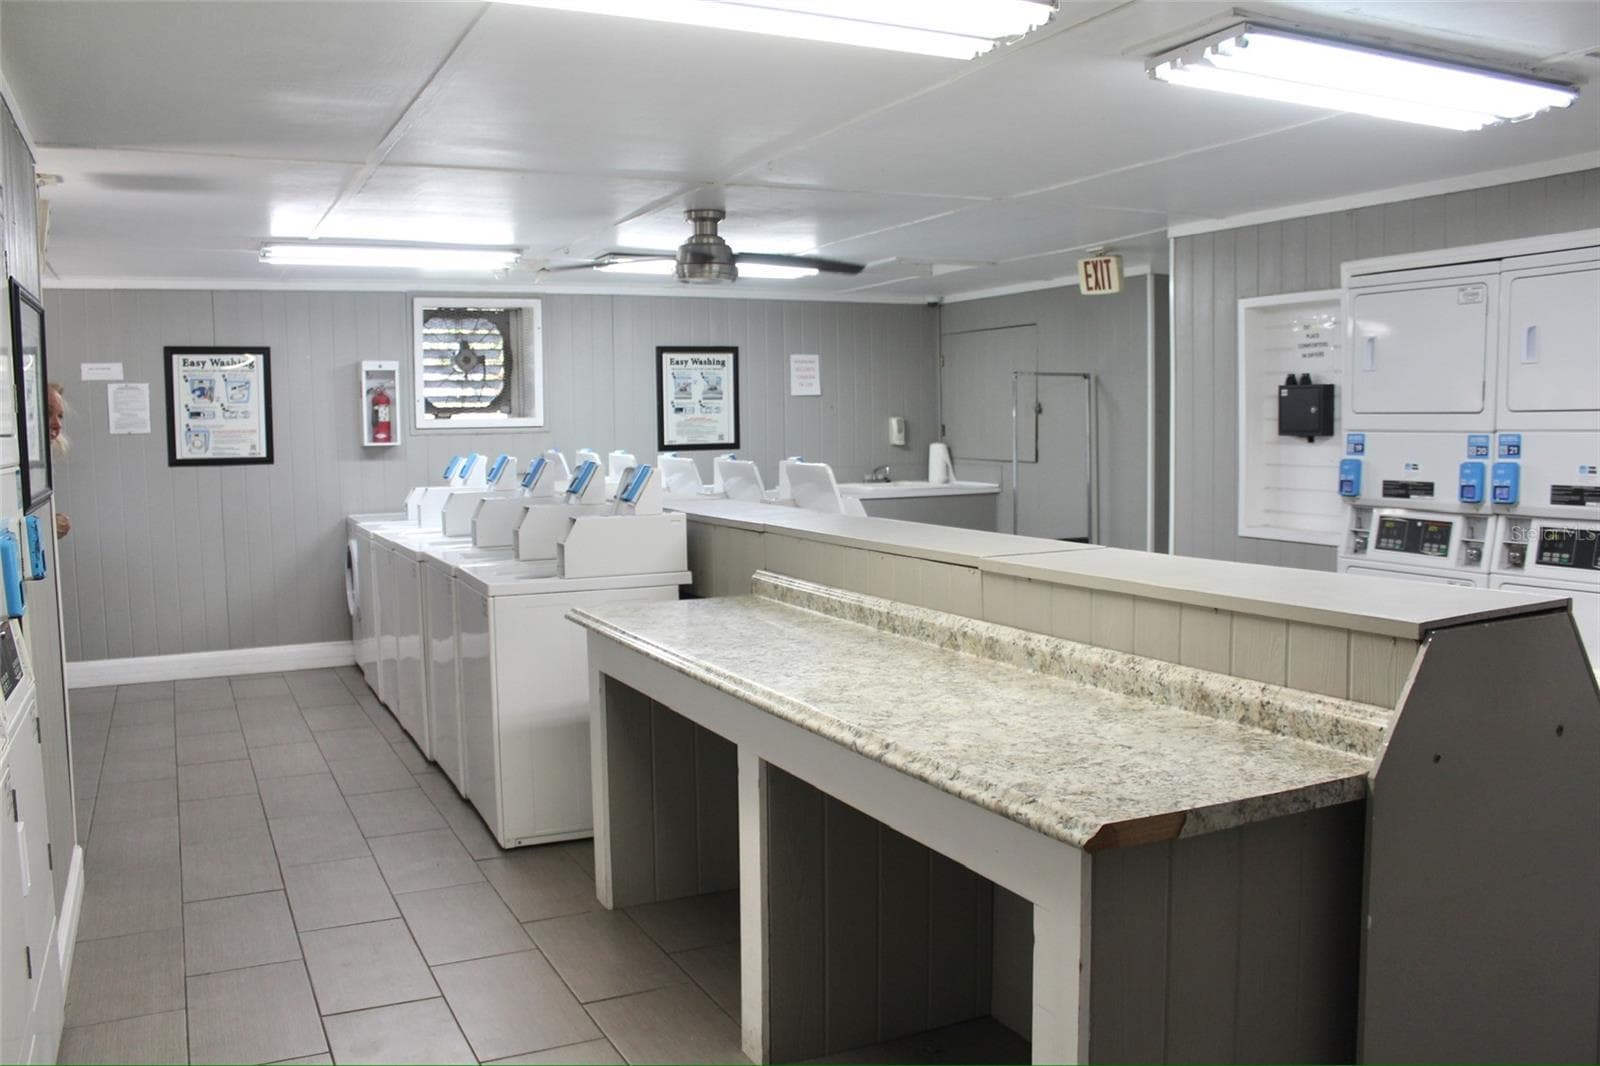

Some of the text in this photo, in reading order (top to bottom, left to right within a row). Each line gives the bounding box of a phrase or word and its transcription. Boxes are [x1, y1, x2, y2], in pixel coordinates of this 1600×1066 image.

[1084, 258, 1113, 291] EXIT
[182, 357, 255, 371] Easy Washig
[669, 358, 726, 368] Easy Washing
